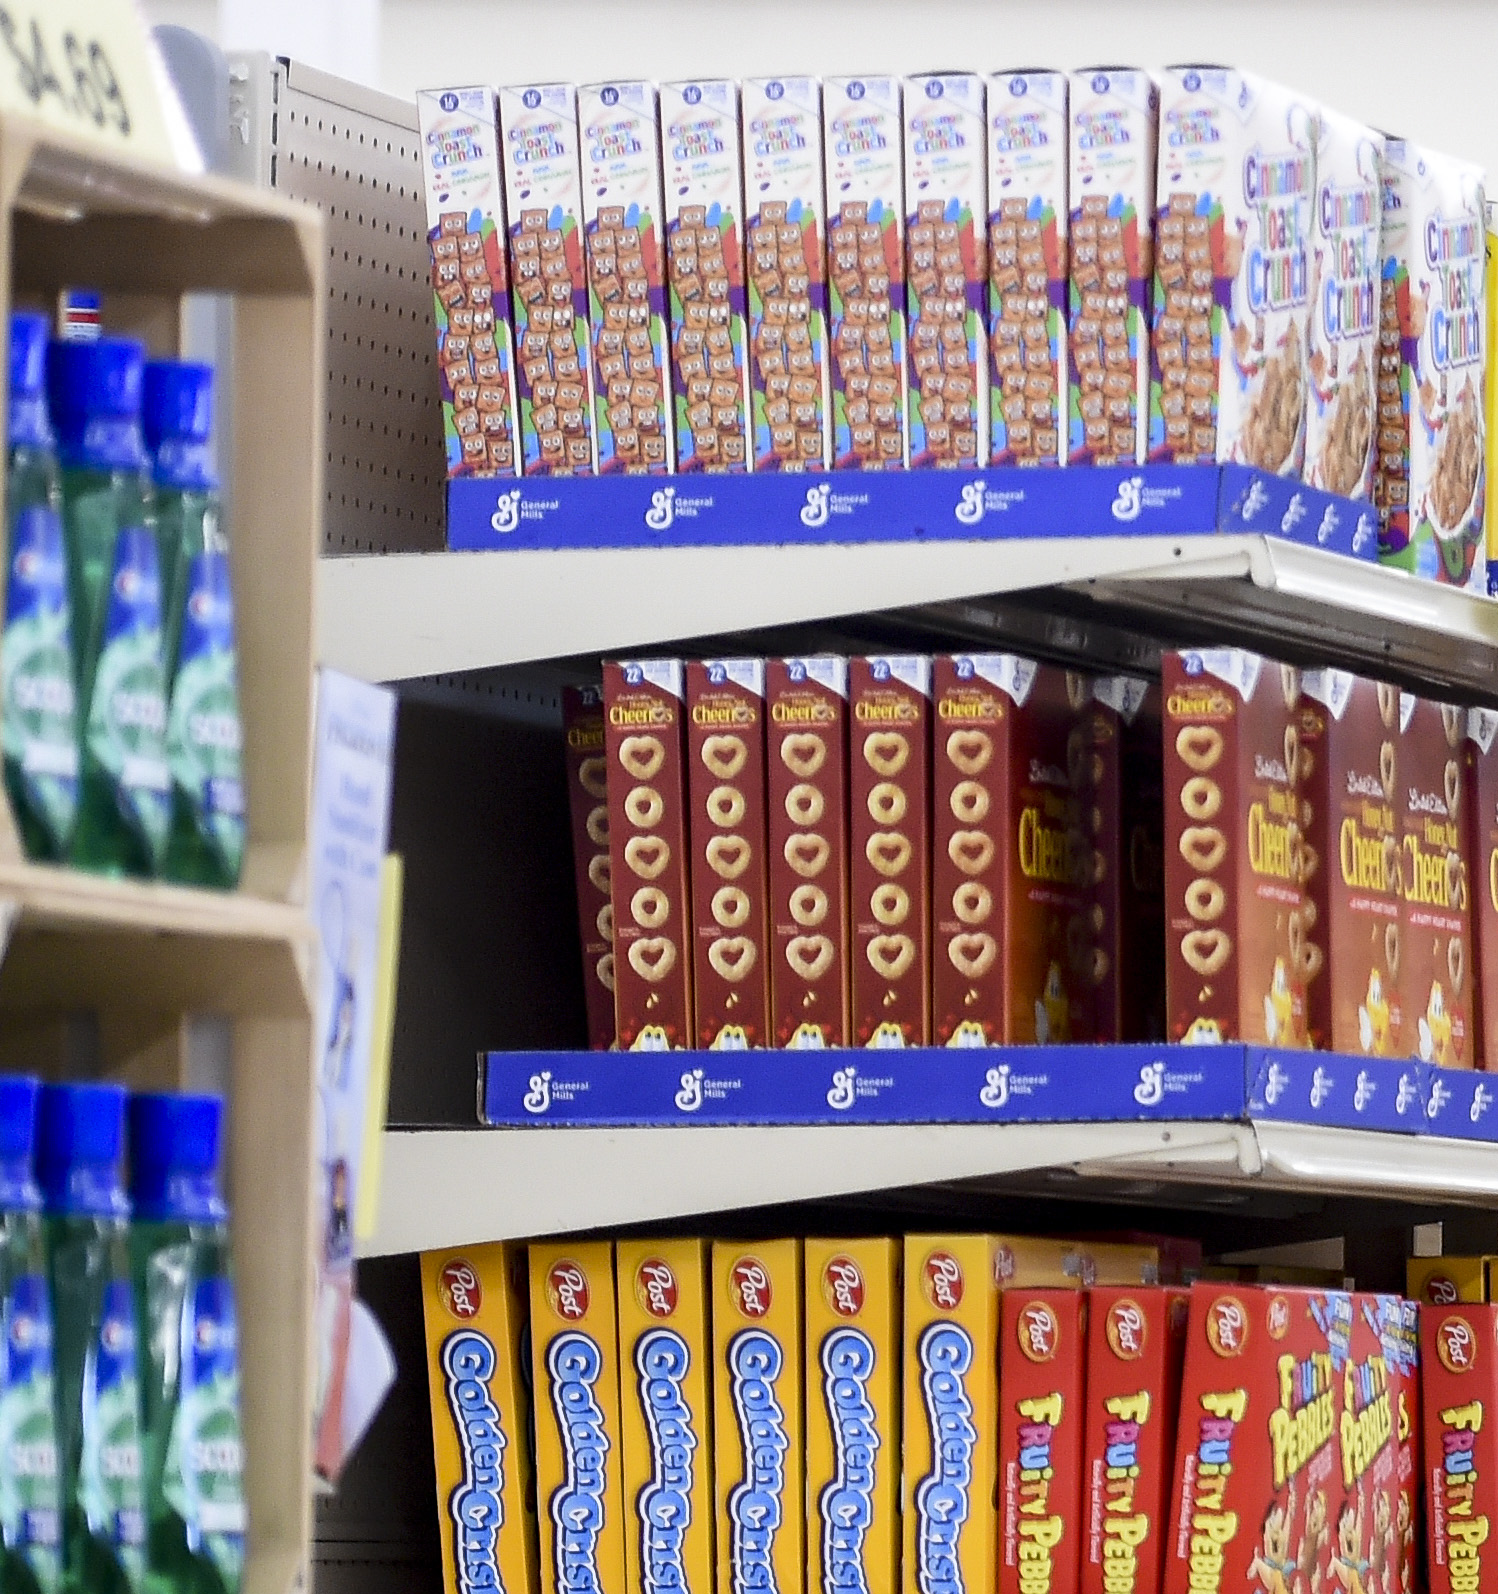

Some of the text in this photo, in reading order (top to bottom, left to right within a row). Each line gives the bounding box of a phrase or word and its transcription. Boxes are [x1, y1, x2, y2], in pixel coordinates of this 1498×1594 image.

[446, 1259, 476, 1316] Post
[553, 1259, 581, 1317] Post
[640, 1256, 669, 1316] Post
[736, 1257, 766, 1315] Post
[829, 1255, 858, 1315] Post
[930, 1252, 958, 1310] Post
[440, 1328, 508, 1496] Golden
[547, 1329, 610, 1497] Golden
[635, 1328, 697, 1497] Golden
[726, 1328, 789, 1497] Golden
[818, 1327, 882, 1497] Golden
[919, 1319, 978, 1490] Golden
[1017, 1390, 1064, 1518] FRUITY
[1105, 1388, 1151, 1514] FRUITY
[1194, 1386, 1248, 1511] FRUITY
[1439, 1400, 1486, 1534] FRUITY
